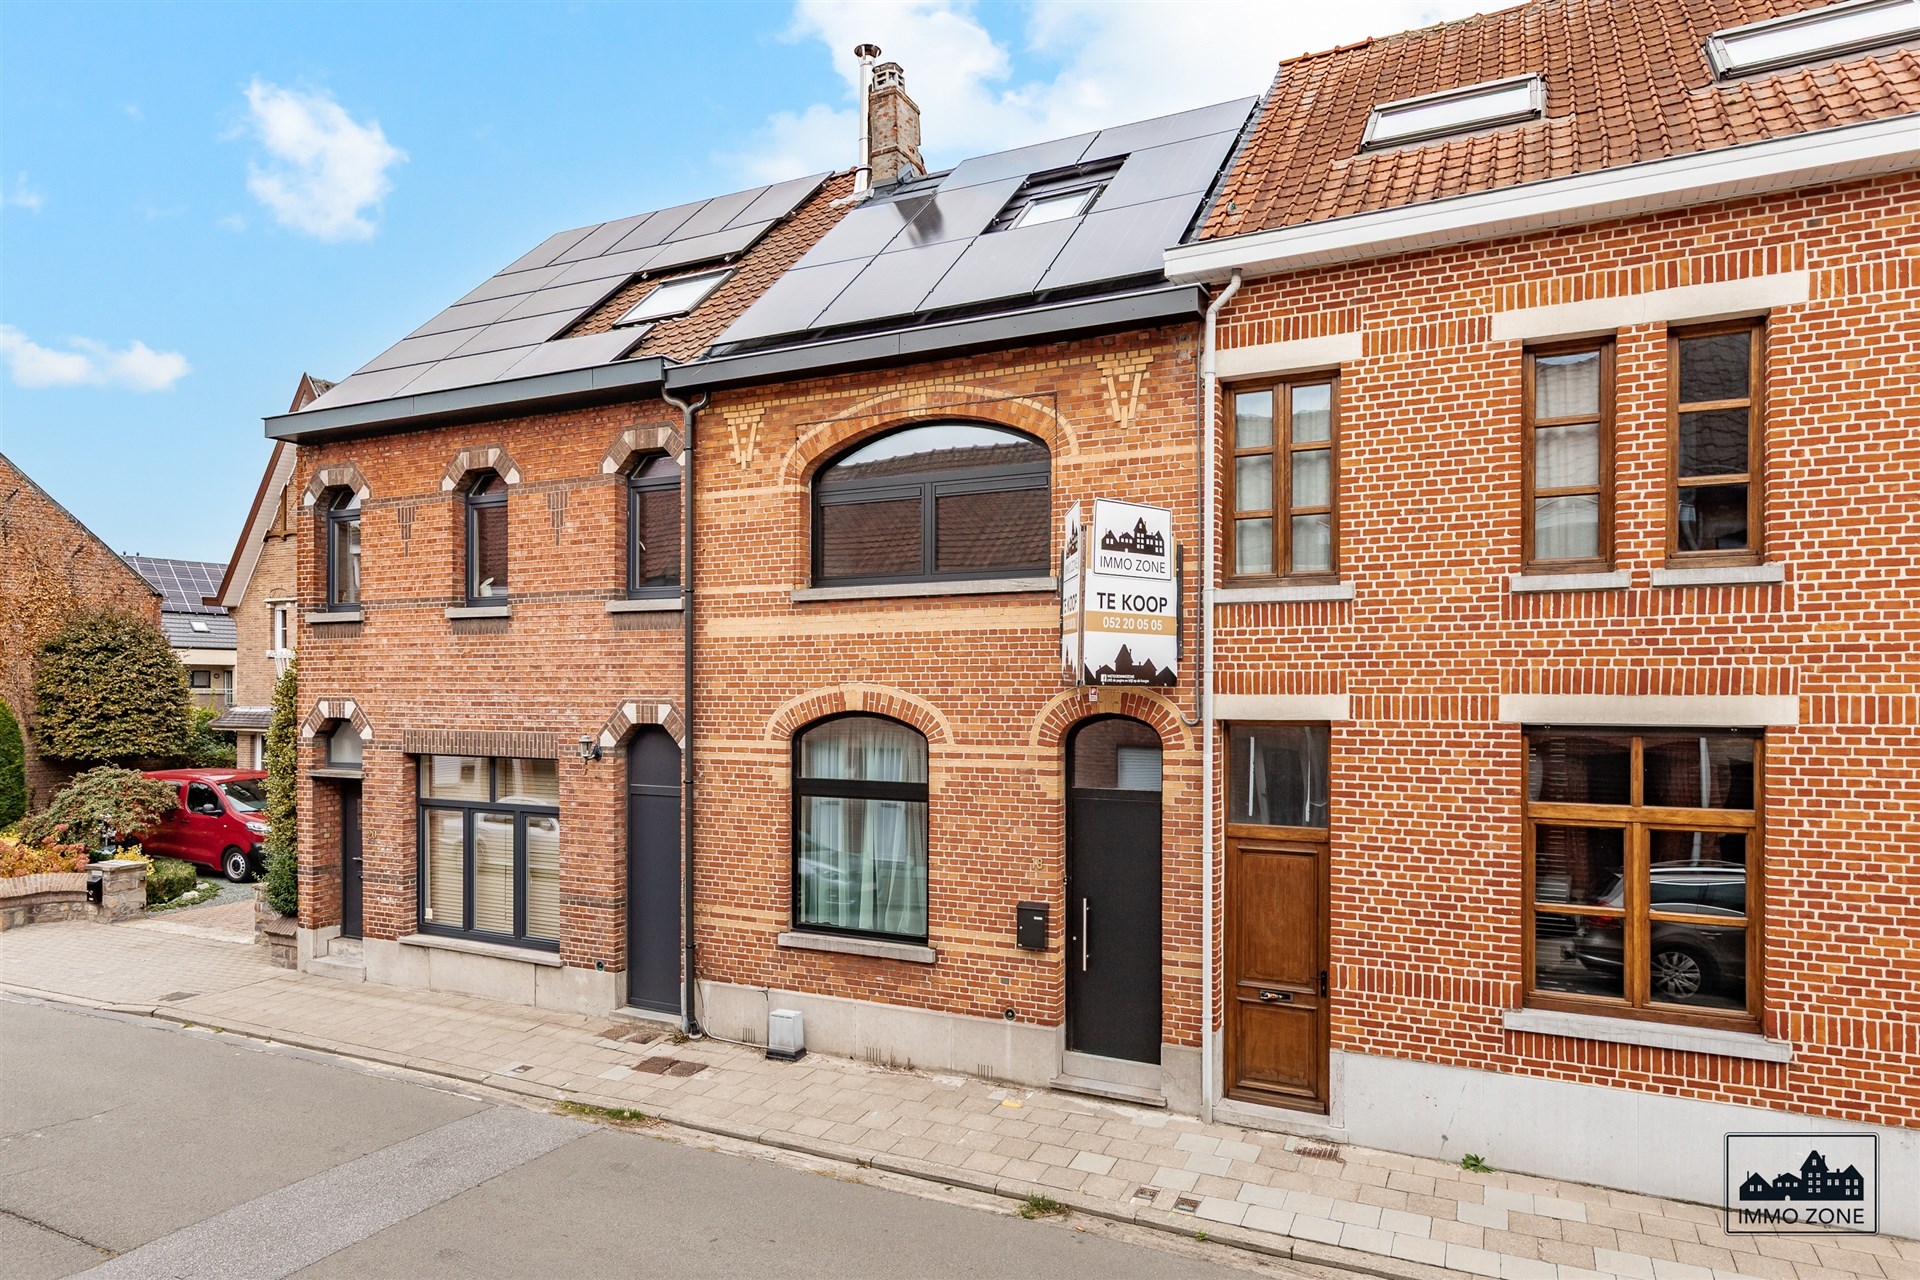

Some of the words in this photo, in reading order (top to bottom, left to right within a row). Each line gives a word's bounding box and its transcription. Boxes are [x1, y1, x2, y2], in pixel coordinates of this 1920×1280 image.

[1100, 556, 1132, 571] IMMO
[1136, 559, 1166, 574] ZONE
[1097, 592, 1116, 610] TE
[1122, 594, 1168, 613] KOOP
[1103, 616, 1121, 629] 052
[1123, 617, 1135, 629] 20
[1137, 618, 1149, 630] 05
[1151, 619, 1163, 631] 05
